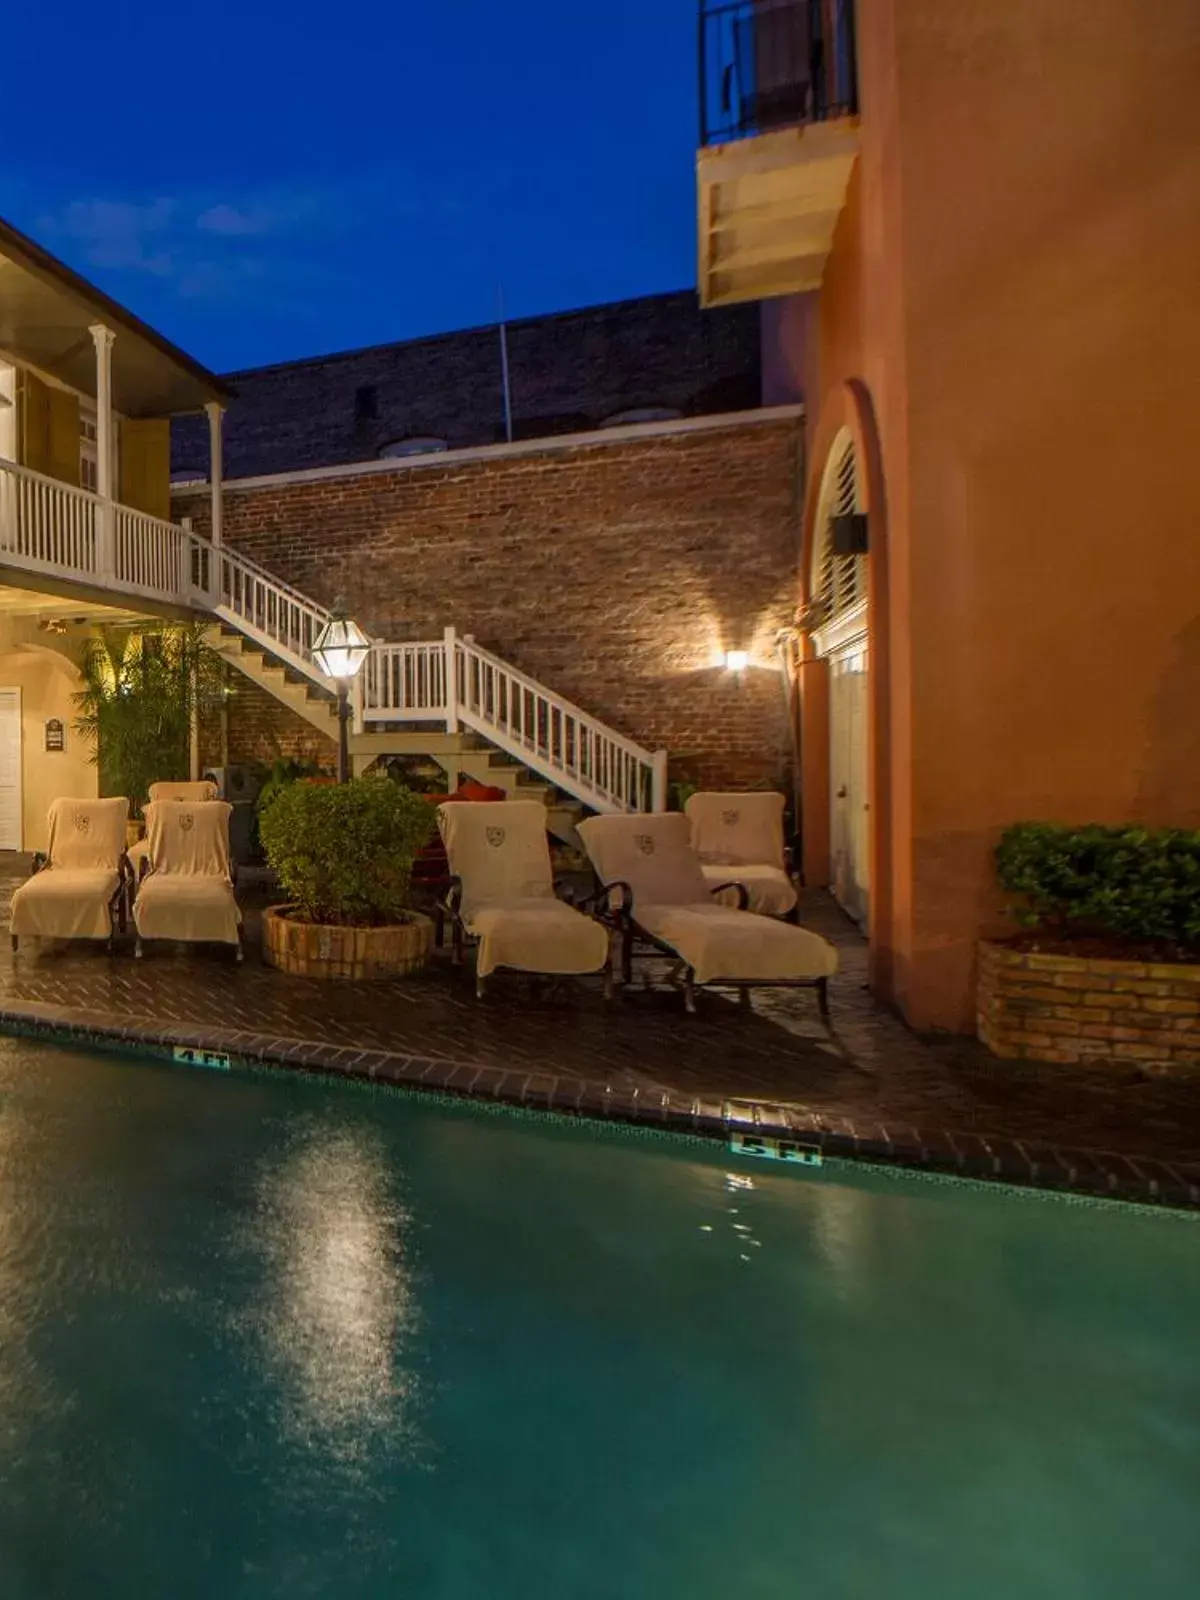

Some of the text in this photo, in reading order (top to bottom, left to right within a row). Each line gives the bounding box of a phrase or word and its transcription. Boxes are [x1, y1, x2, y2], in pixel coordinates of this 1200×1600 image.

[179, 1050, 228, 1066] 4 FT
[740, 1137, 819, 1163] 5 FT
